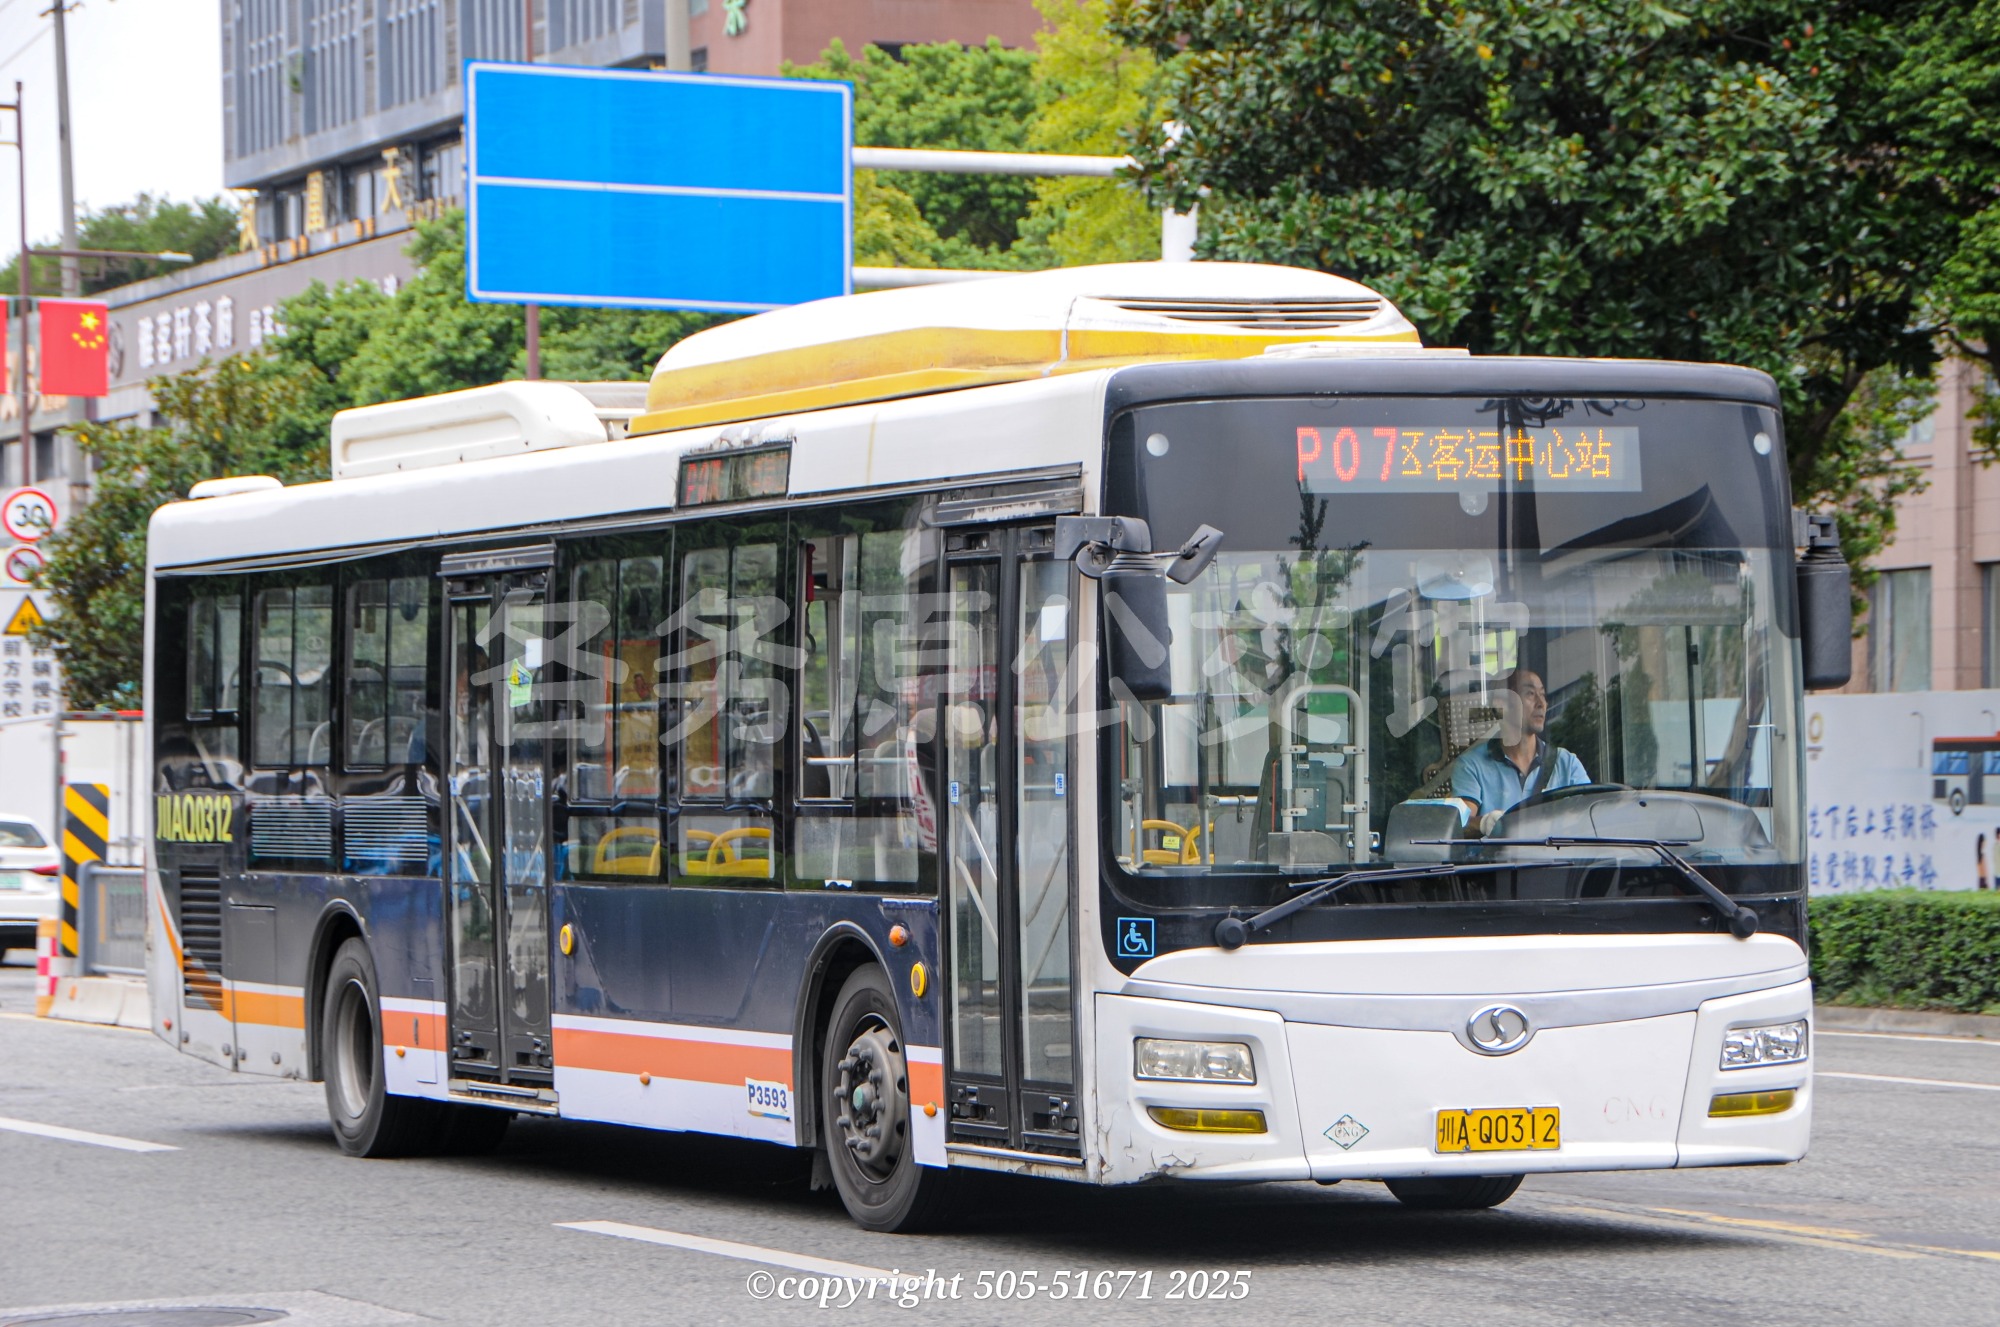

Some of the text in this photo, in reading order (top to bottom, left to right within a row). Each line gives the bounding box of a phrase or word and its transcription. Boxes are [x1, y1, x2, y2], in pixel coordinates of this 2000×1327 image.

[1297, 427, 1396, 482] P07
[14, 504, 46, 527] 30
[3, 640, 22, 717] 前方学校
[748, 1083, 787, 1109] P3593
[1603, 1096, 1666, 1125] CNG
